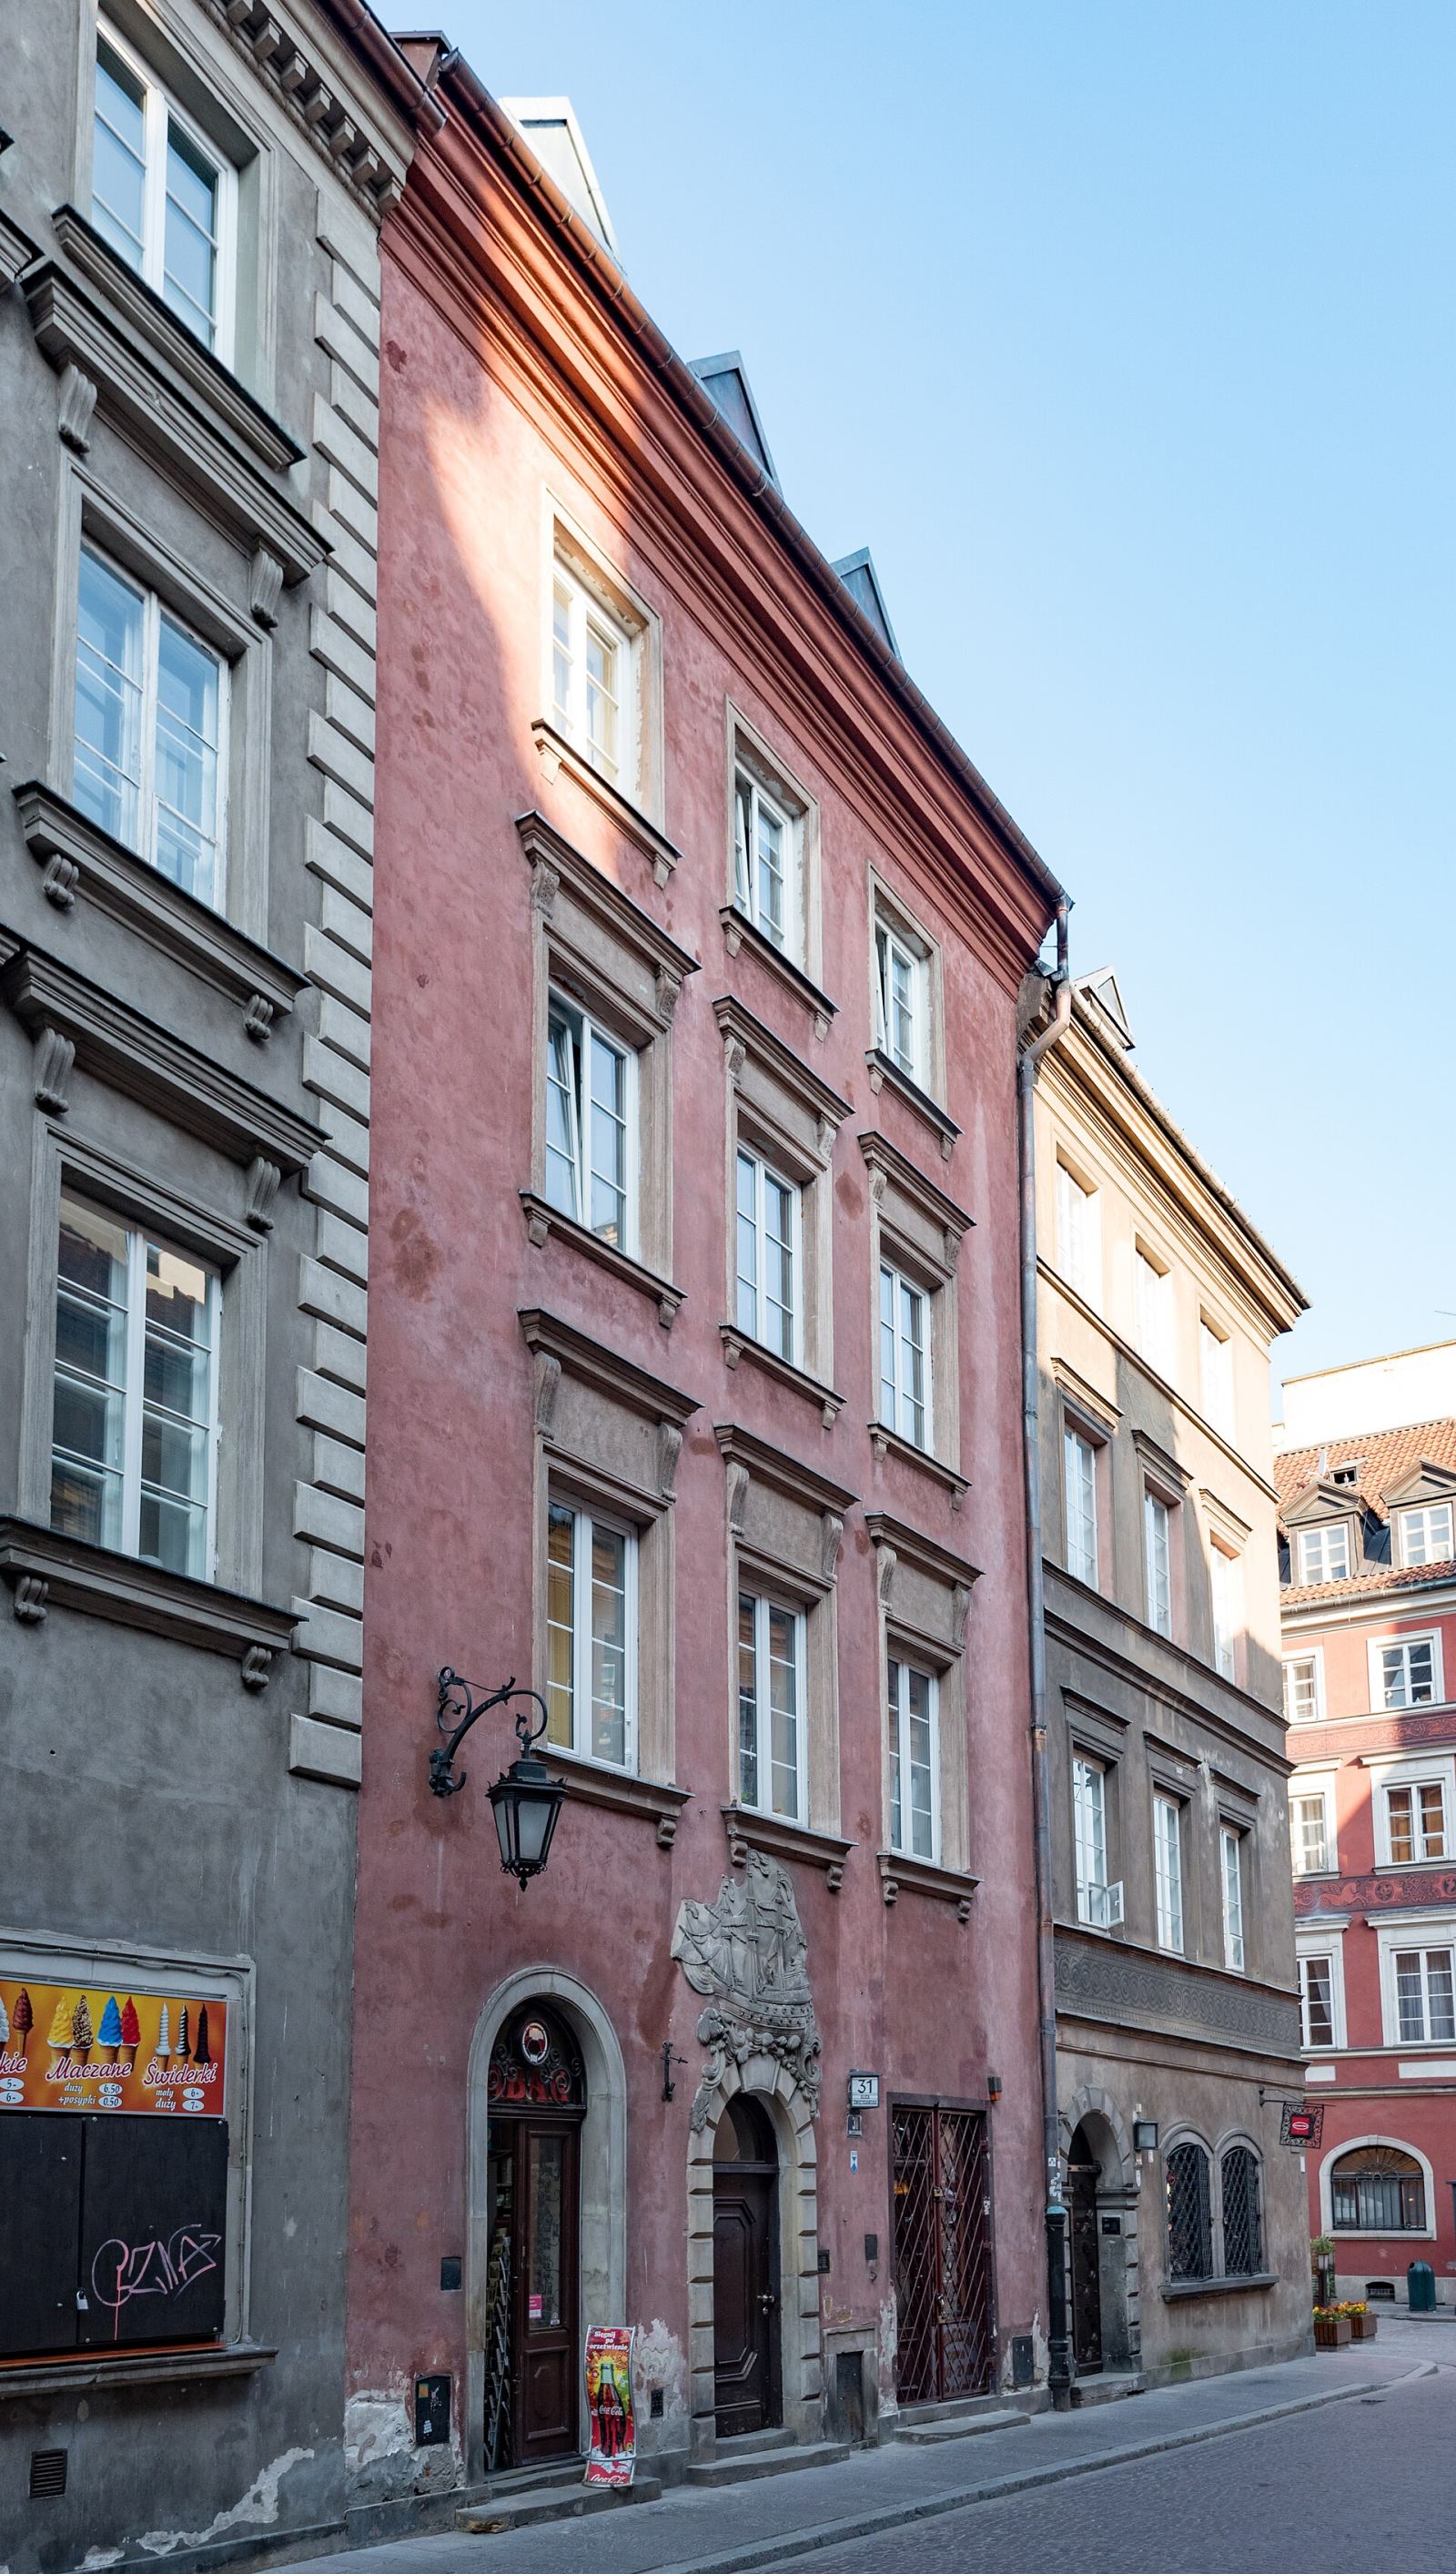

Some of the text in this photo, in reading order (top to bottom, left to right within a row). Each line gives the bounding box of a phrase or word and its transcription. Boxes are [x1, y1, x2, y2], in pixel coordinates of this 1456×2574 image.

[46, 2057, 132, 2081] Maczane
[143, 2057, 217, 2085] Świderki
[104, 2085, 120, 2094] 6.50
[857, 2079, 873, 2093] 31
[156, 2088, 174, 2099] mały
[103, 2097, 119, 2107] 0.50
[156, 2097, 176, 2111] duży
